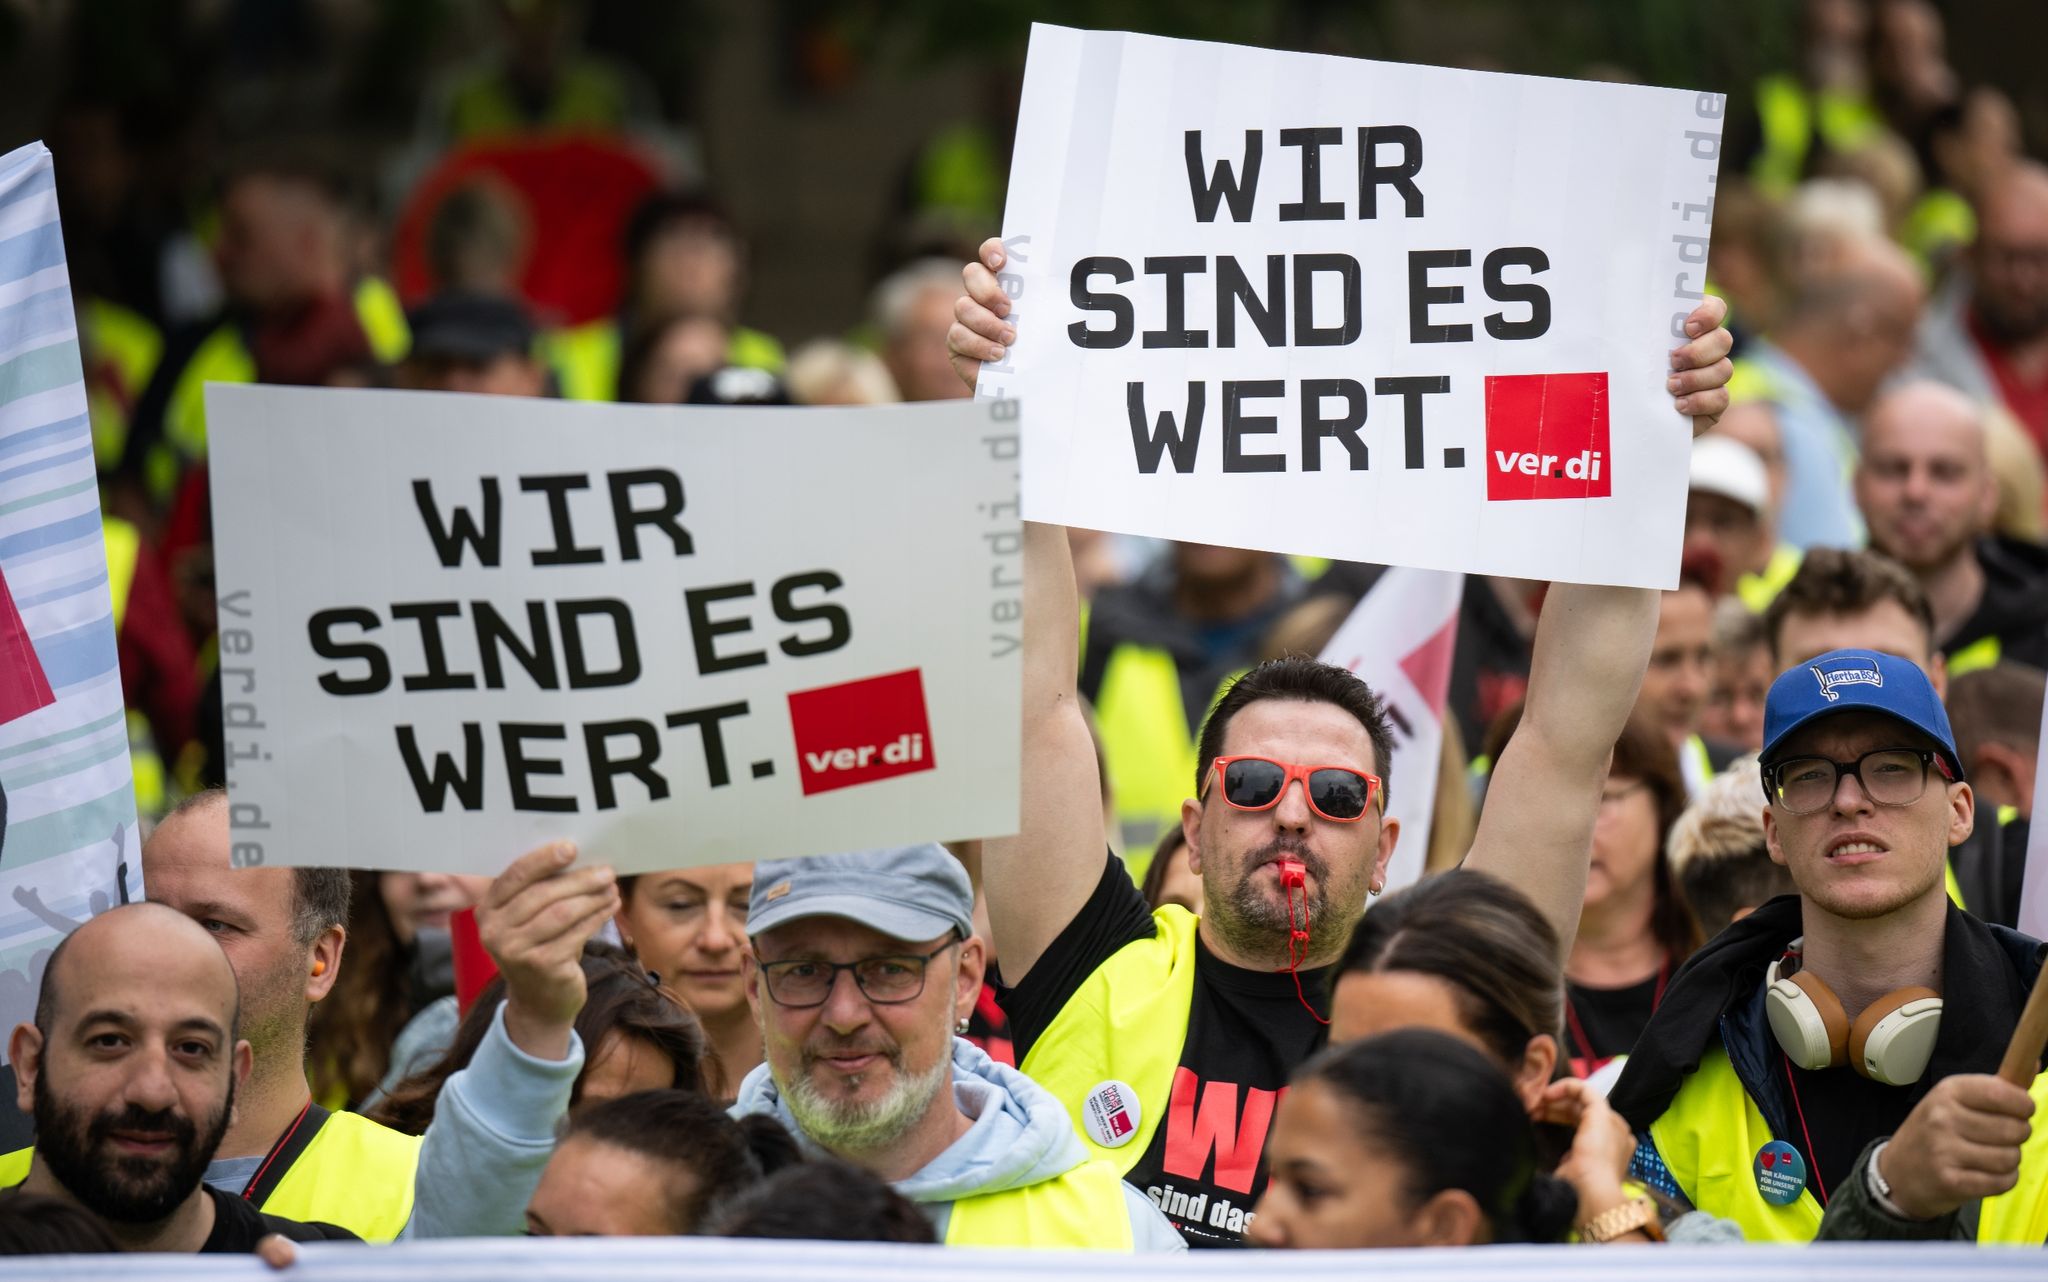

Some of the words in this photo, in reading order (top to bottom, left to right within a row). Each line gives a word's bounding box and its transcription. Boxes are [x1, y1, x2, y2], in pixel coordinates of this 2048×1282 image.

[1185, 126, 1424, 222] WIR
[1668, 92, 1726, 376] erdi.de
[1068, 254, 1361, 348] SIND
[1409, 247, 1551, 343] ES
[1127, 376, 1464, 473] WERT.
[1495, 450, 1601, 481] ver.di
[412, 469, 694, 568] WIR
[977, 397, 1024, 659] verdi.de
[308, 598, 641, 696] SIND
[685, 571, 851, 675] ES
[218, 590, 273, 867] verdi.de
[395, 701, 774, 813] WERT.
[805, 733, 922, 773] ver.di
[1147, 1184, 1208, 1222] sind
